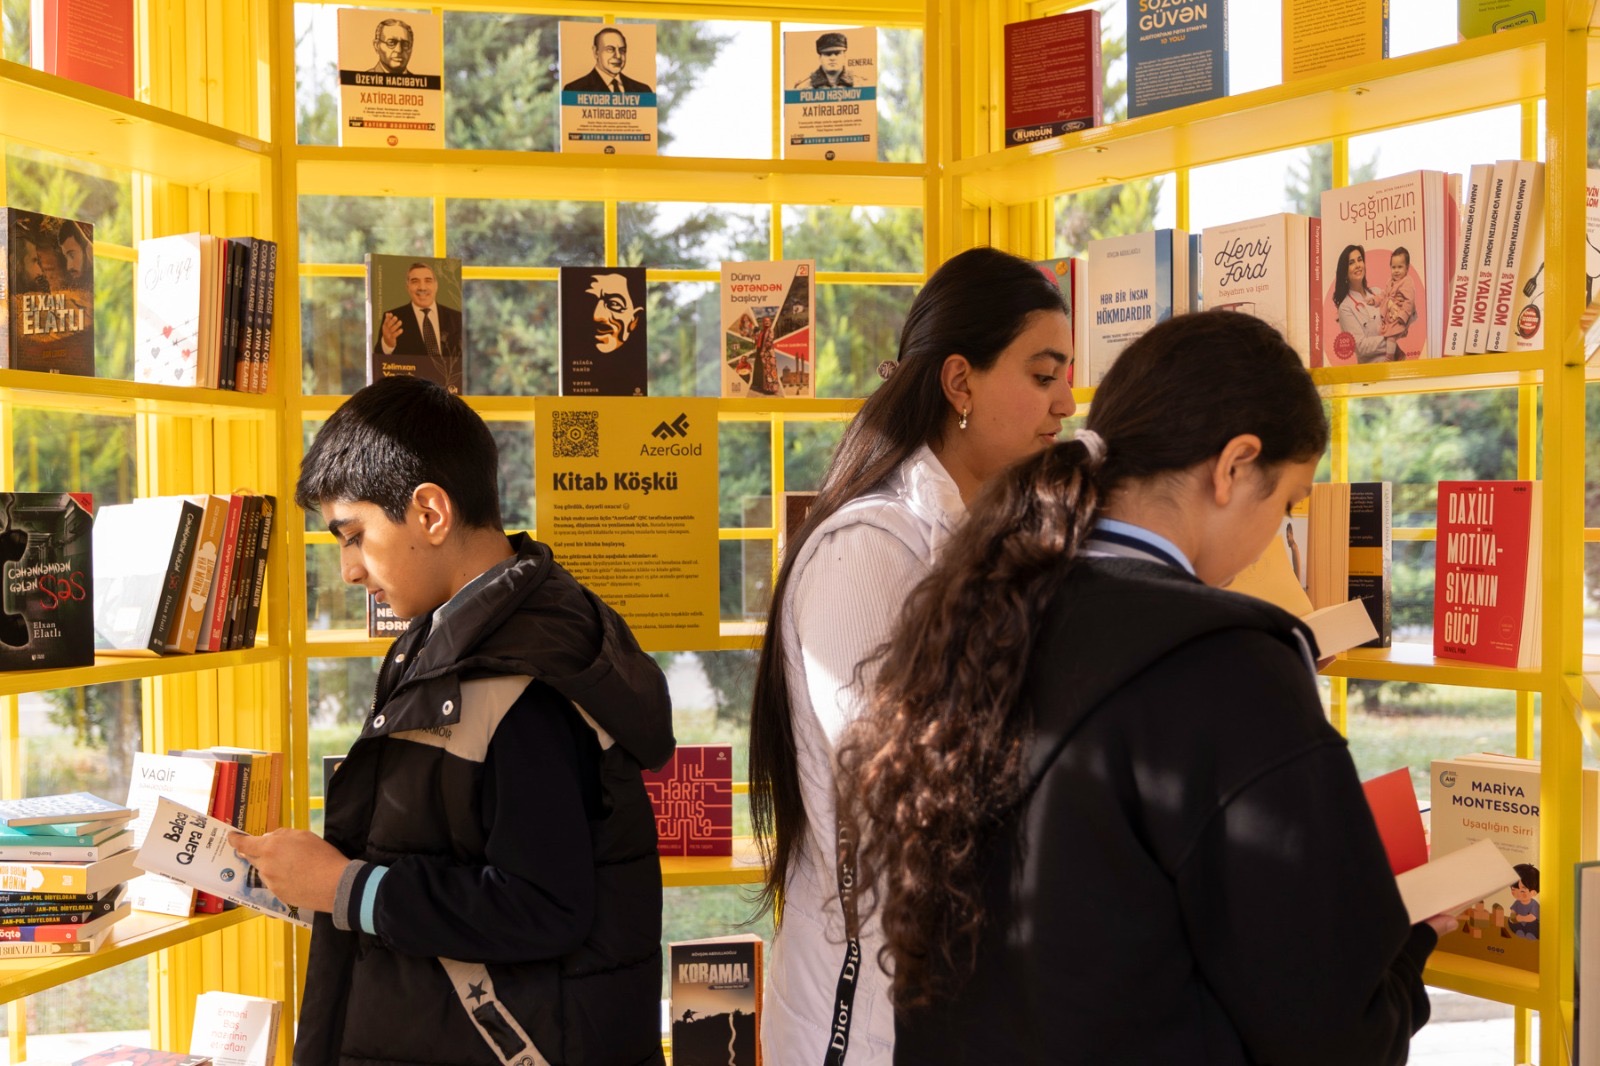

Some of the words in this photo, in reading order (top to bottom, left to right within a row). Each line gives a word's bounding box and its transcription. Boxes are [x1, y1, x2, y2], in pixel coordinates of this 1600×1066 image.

[1139, 3, 1208, 30] GÜVƏN
[848, 58, 874, 66] GENERAL
[356, 73, 384, 85] ÜZEYİR
[386, 76, 428, 88] HACIBƏYLİ
[360, 91, 424, 106] XATİRƏLƏRDƏ
[577, 94, 610, 104] HEYDƏR
[612, 93, 640, 105] ƏLİYEV
[800, 90, 825, 102] POLAD
[827, 89, 862, 102] HƏŞİMOV
[582, 108, 637, 120] XATİRƏLƏRDƏ
[802, 104, 860, 117] XATİRƏLƏRDƏ
[1015, 126, 1053, 139] NURGÜN
[1340, 191, 1415, 223] Uşağınızın
[1364, 212, 1416, 240] Həkimi
[1464, 214, 1474, 242] HƏYATIN
[1489, 211, 1499, 238] HƏYATIN
[1512, 212, 1522, 240] HƏYATIN
[1461, 244, 1470, 270] MƏNASI
[1484, 239, 1494, 266] MƏNASI
[1506, 242, 1516, 268] MƏNASI
[731, 272, 760, 282] Dünya
[1220, 260, 1267, 286] Ford
[731, 284, 782, 292] VƏTƏNDƏN
[1100, 294, 1112, 304] HƏR
[1116, 290, 1126, 303] BİR
[1130, 288, 1148, 301] İNSAN
[1218, 287, 1244, 298] həyatım
[1256, 283, 1269, 294] işim
[23, 294, 65, 312] ELXAN
[731, 294, 768, 304] başlayır
[1450, 282, 1468, 327] YALOM
[1472, 280, 1491, 324] YALOM
[1494, 282, 1512, 326] YALOM
[24, 308, 84, 334] ELATLI
[1096, 304, 1152, 325] HÖKMDARDIR
[640, 444, 702, 456] AzerGold
[553, 472, 608, 491] Kitab
[614, 472, 678, 495] Köşkü
[1449, 487, 1494, 525] DAXİLİ
[1448, 528, 1503, 566] MOTİVA-
[8, 560, 72, 580] CƏHƏNNƏMDƏN
[10, 578, 38, 592] GƏLƏN
[1446, 566, 1498, 607] SİYANIN
[34, 628, 61, 638] Elatlı
[1445, 606, 1478, 646] GÜCÜ
[141, 767, 176, 782] VAQİF
[1472, 781, 1525, 798] MARİYA
[1452, 794, 1540, 817] MONTESSOR
[1462, 818, 1510, 832] Uşaqlığın
[1512, 825, 1534, 836] Sirri
[176, 830, 202, 866] Qara
[0, 930, 21, 940] öqtə
[678, 962, 750, 984] KORAMAL
[832, 1000, 850, 1051] Dior
